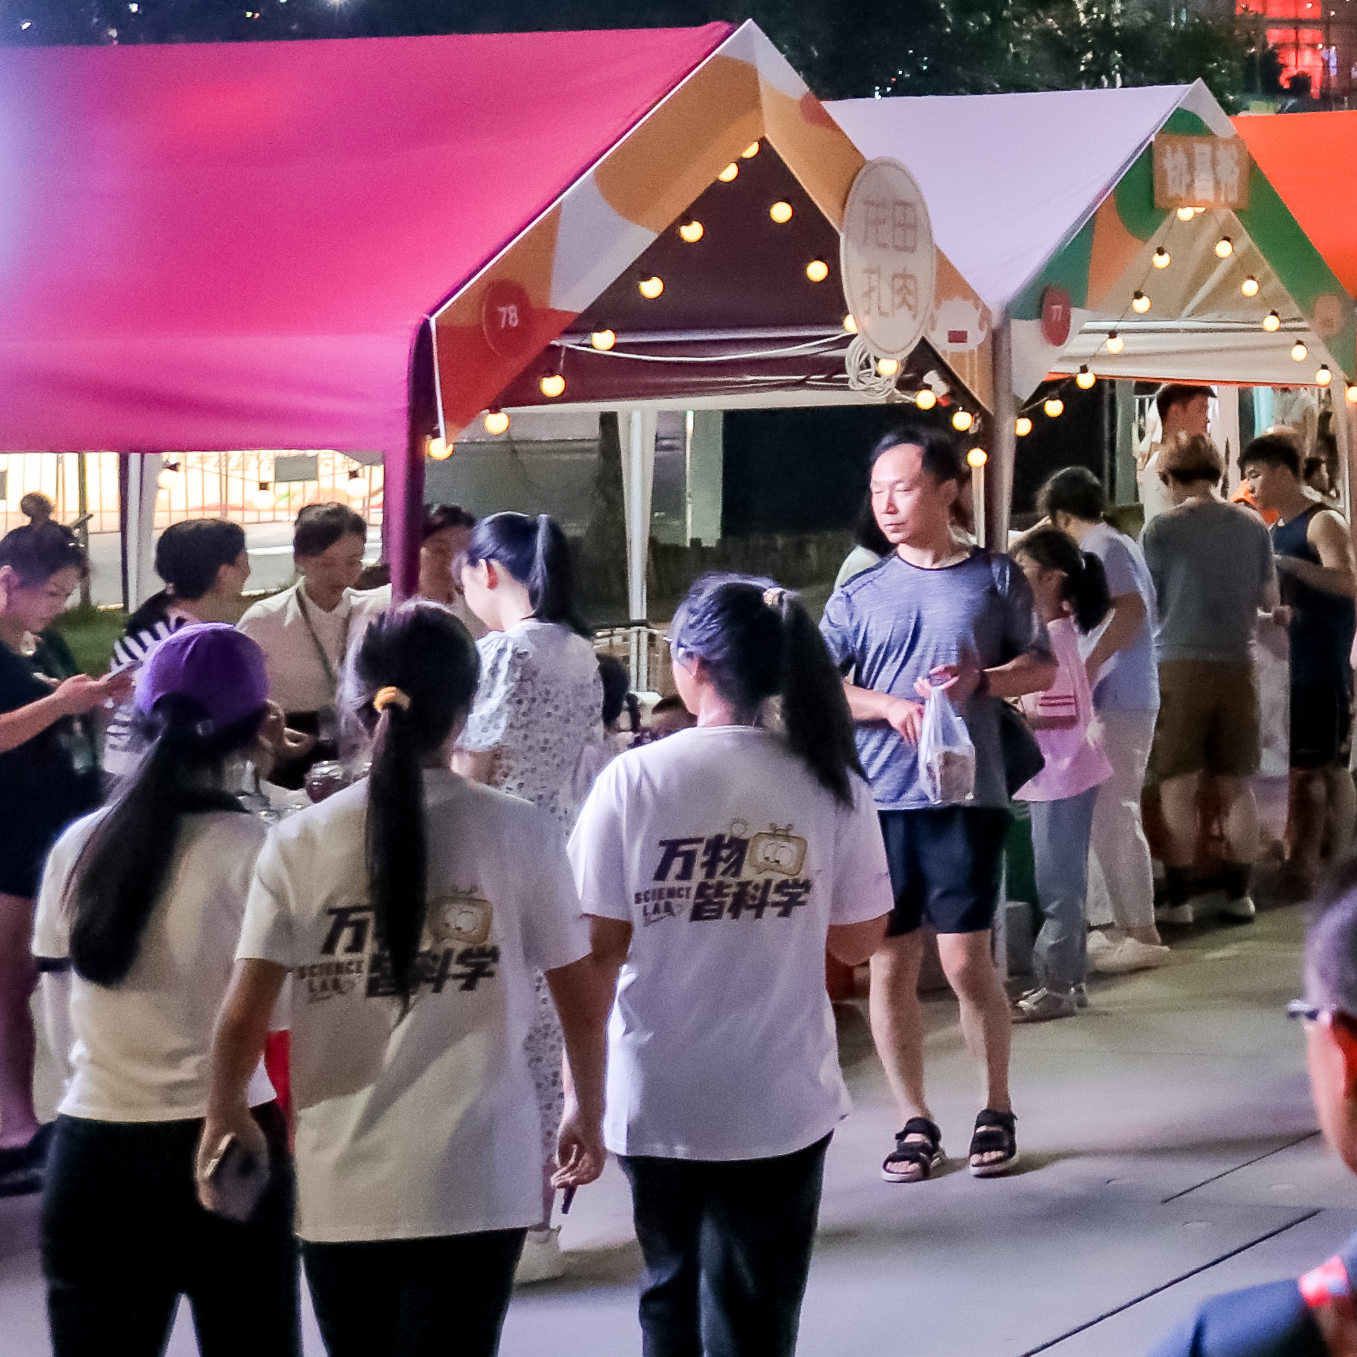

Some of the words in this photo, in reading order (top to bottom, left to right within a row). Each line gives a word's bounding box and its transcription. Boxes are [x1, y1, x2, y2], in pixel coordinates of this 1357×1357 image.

[497, 304, 519, 329] 78
[653, 834, 751, 881] 万物
[634, 886, 692, 905] SCIENCE
[690, 878, 813, 922] 皆科学
[320, 905, 373, 954] 万
